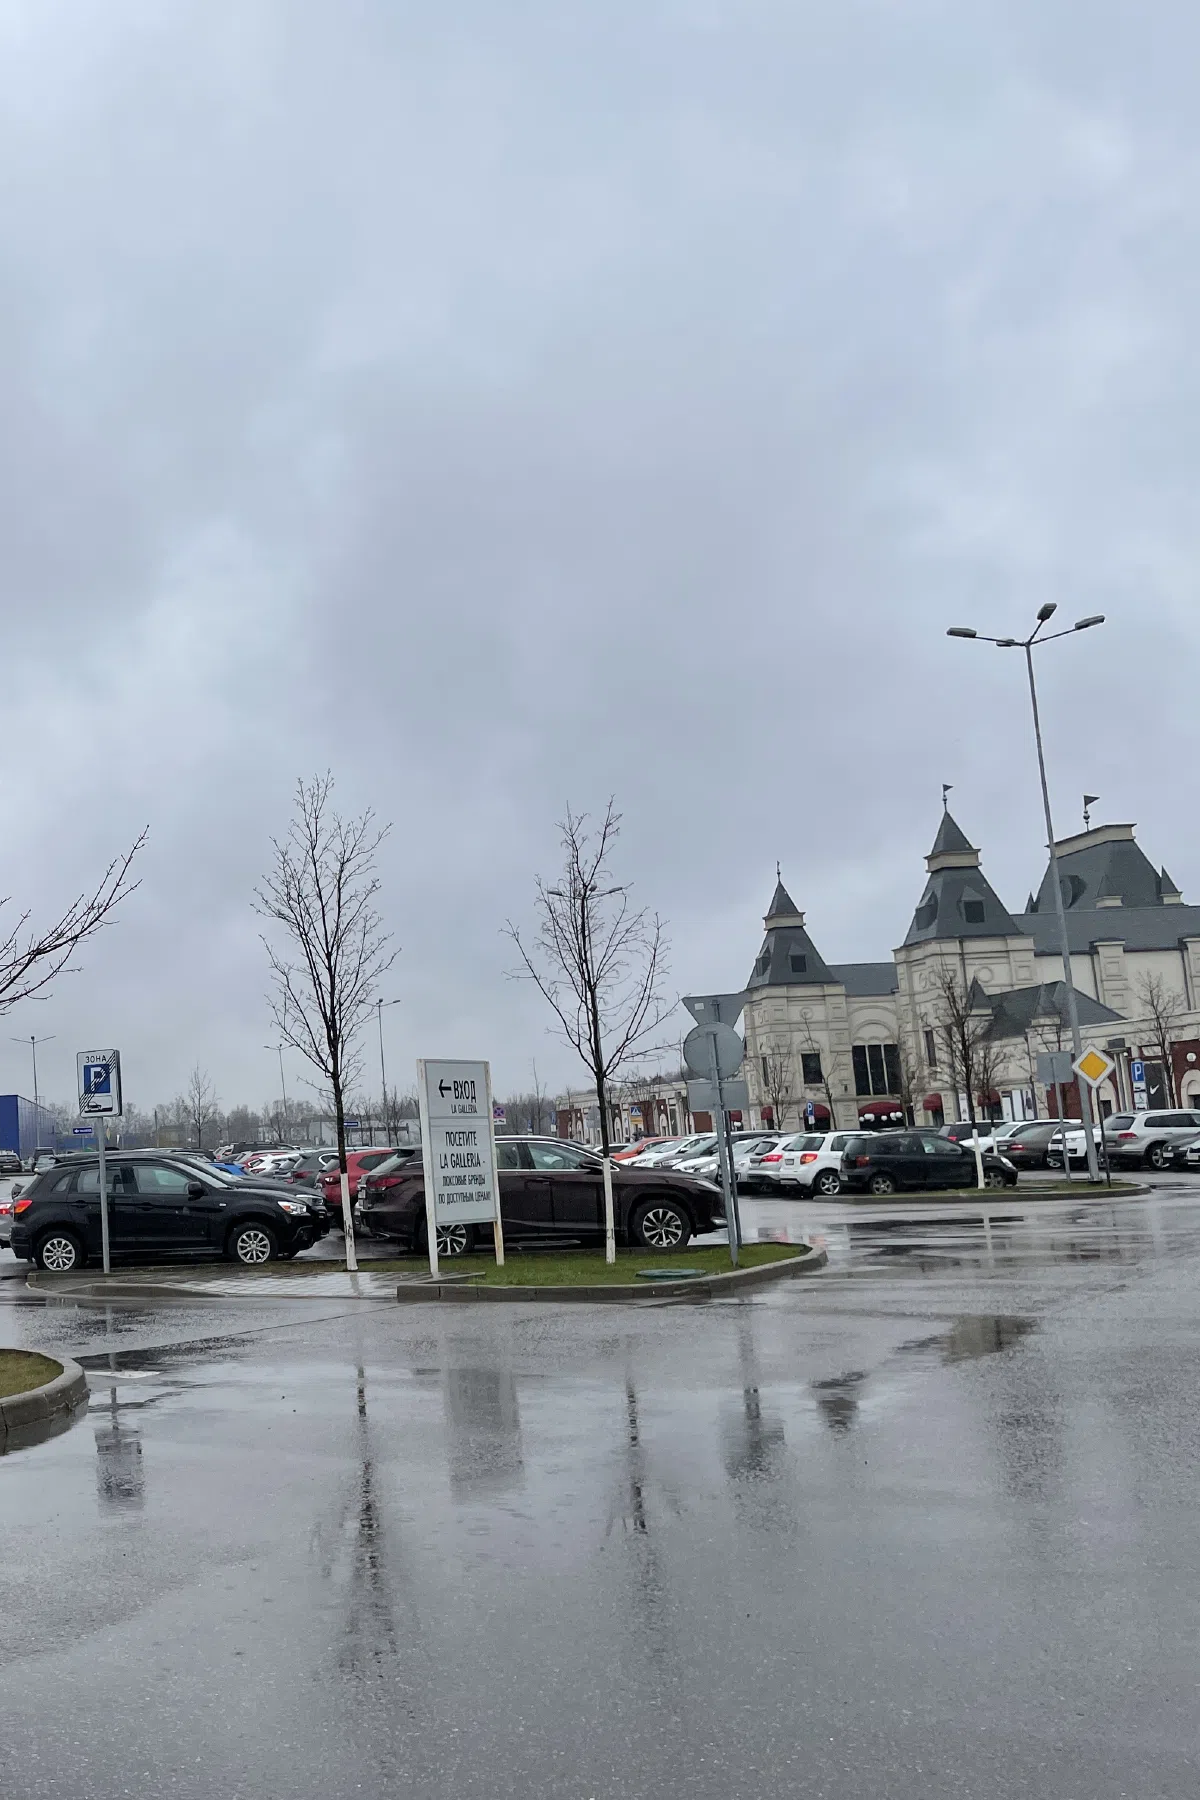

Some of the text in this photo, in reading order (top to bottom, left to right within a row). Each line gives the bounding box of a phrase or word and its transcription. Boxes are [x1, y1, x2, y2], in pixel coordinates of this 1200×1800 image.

[85, 1054, 107, 1064] ЗОНА
[1134, 1063, 1142, 1081] P
[453, 1080, 477, 1103] ВХОД
[451, 1104, 477, 1114] LA GALLERIA
[445, 1131, 477, 1147] ПОСЕТИТЕ
[439, 1153, 449, 1169] LA
[450, 1152, 481, 1169] GALLERIA
[438, 1193, 445, 1204] ПО
[446, 1192, 474, 1205] ДОСТУПНЫМ
